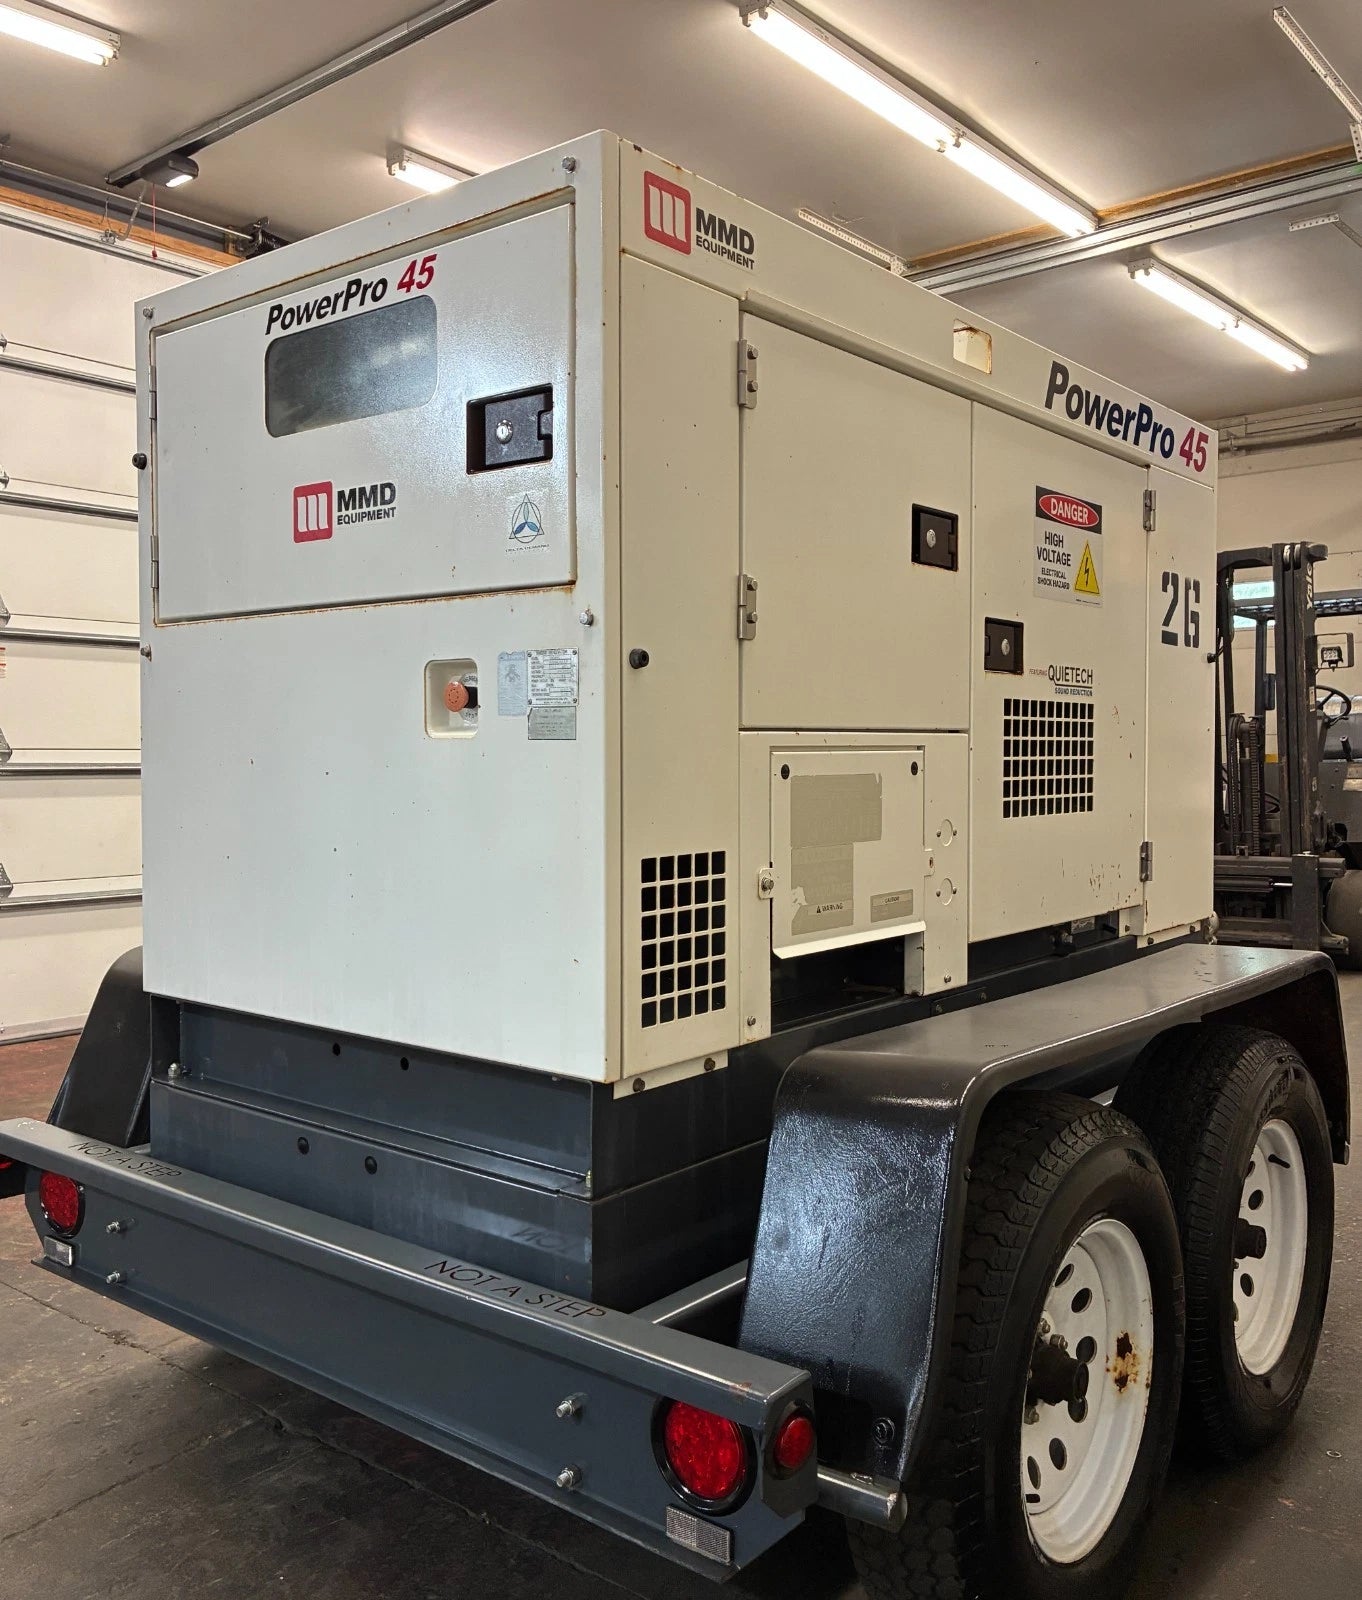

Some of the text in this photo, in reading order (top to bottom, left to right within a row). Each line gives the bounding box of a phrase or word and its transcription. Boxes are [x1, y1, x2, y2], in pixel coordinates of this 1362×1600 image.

[695, 207, 755, 255] MMD
[695, 234, 755, 270] EQUIPMENT
[264, 253, 438, 336] PowerPro 45
[1044, 360, 1209, 473] PowerPro 45
[337, 482, 396, 513] MMD
[1050, 497, 1089, 525] DANGER
[337, 506, 397, 526] EQUIPMENT
[1044, 530, 1065, 549] HIGH
[1036, 545, 1072, 567] VOLTAGE
[1037, 576, 1070, 590] SHOCK HAZARD
[1041, 566, 1067, 580] ELECTRICAL
[1048, 664, 1093, 685] QUIETECH
[1055, 687, 1069, 695] SOUND
[68, 1141, 121, 1159] NOT
[127, 1161, 182, 1177] STEP
[424, 1260, 607, 1319] NOT A STEP
